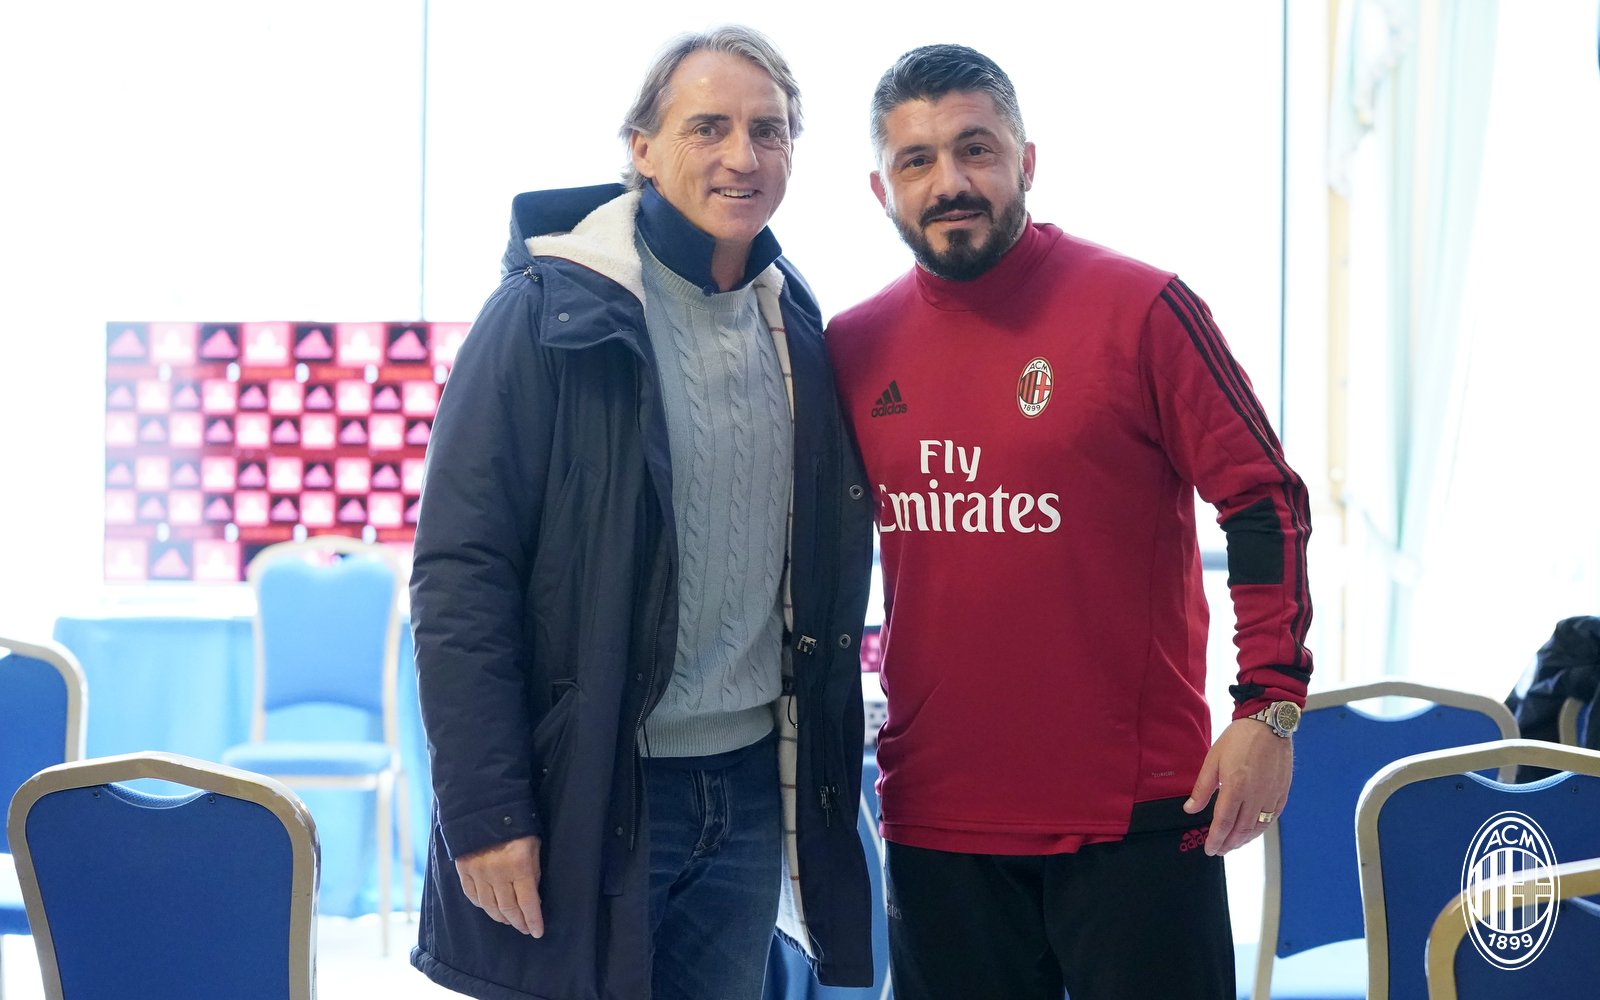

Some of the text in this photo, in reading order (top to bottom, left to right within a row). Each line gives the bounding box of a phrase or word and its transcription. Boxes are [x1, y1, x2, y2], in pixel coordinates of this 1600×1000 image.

[1028, 361, 1048, 373] ACM
[871, 403, 908, 417] adidas
[1023, 404, 1041, 412] 1899
[919, 439, 981, 482] Fly
